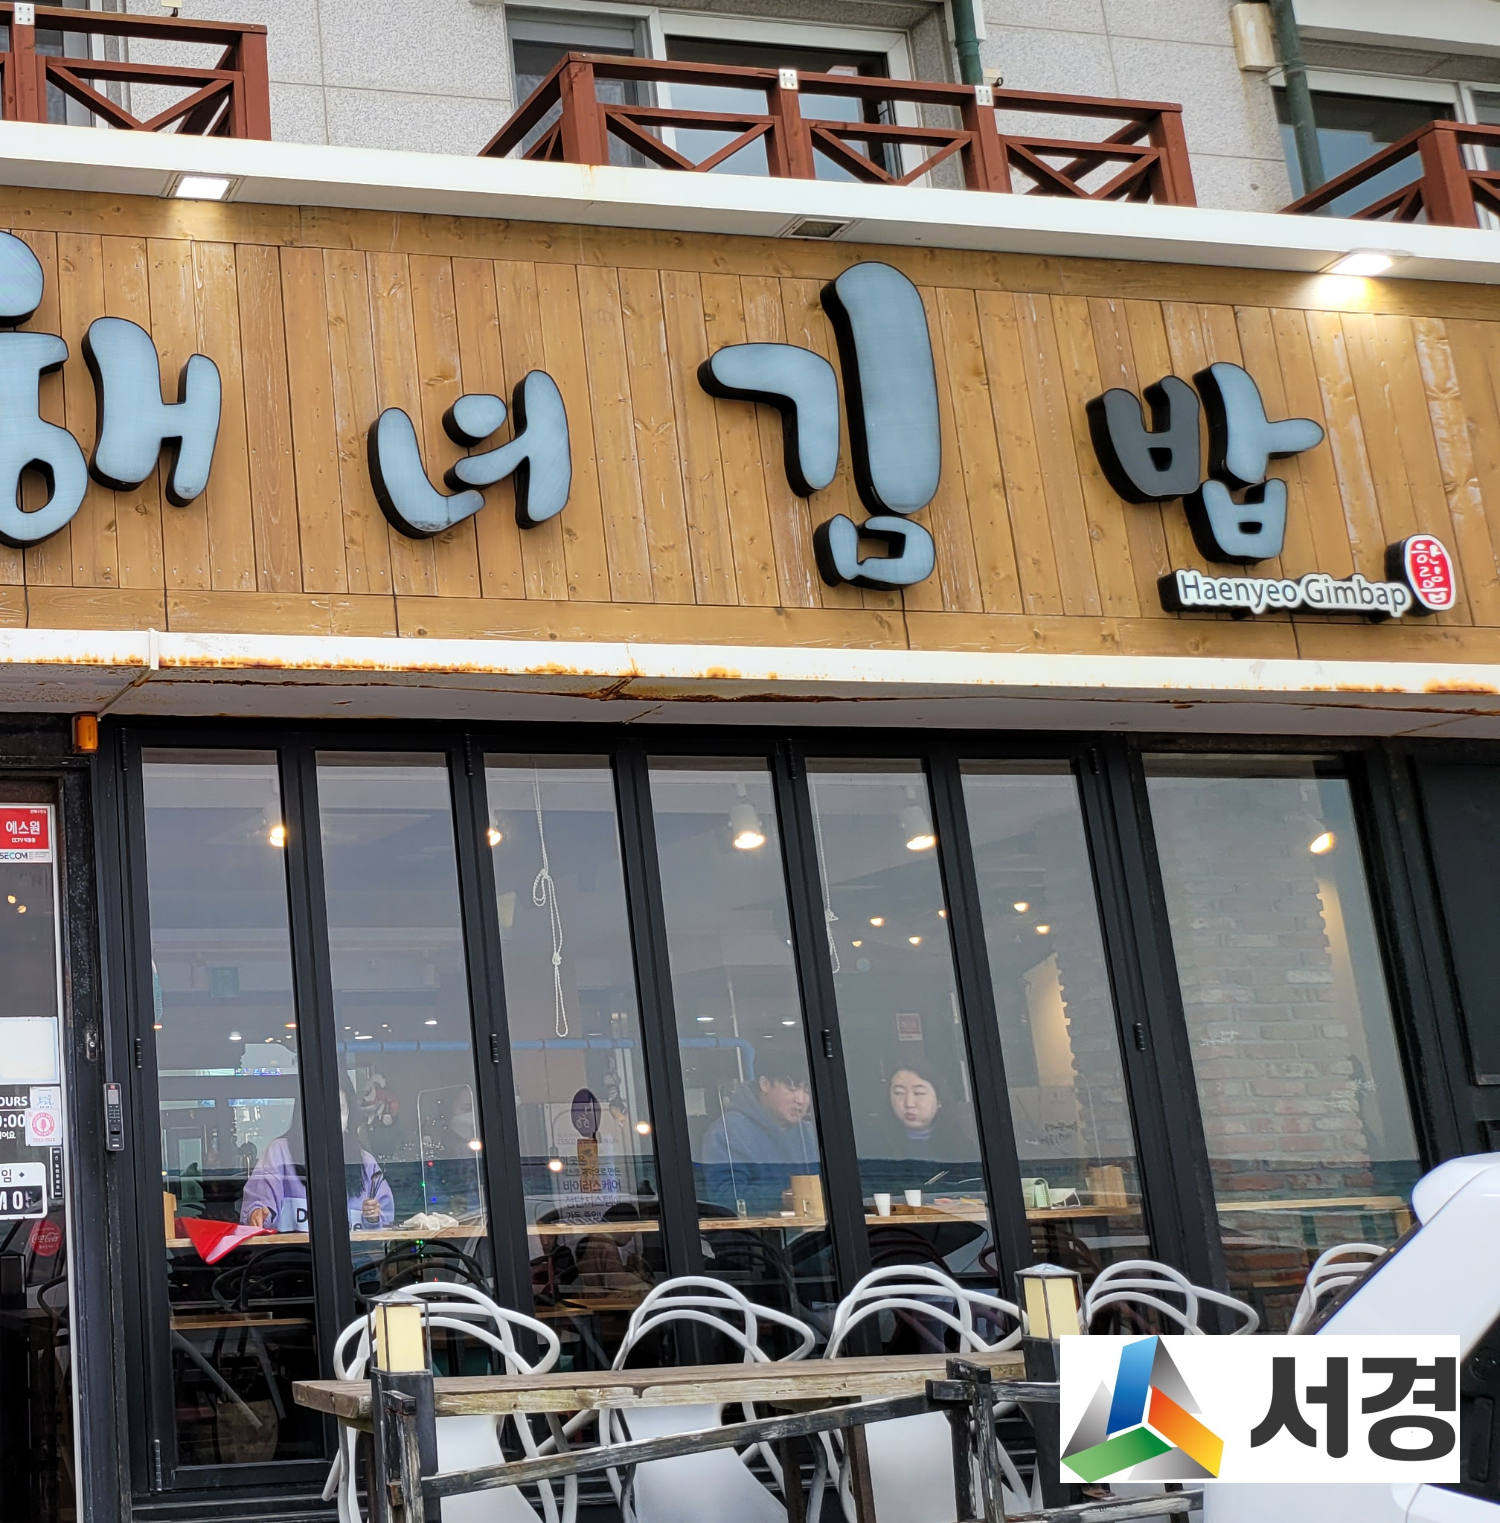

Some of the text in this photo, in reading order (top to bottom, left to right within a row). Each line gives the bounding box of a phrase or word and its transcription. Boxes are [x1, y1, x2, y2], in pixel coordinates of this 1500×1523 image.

[1180, 574, 1407, 614] Haenyeo Gimbap
[5, 820, 41, 835] 에스원
[563, 1179, 621, 1193] 바이러스케어
